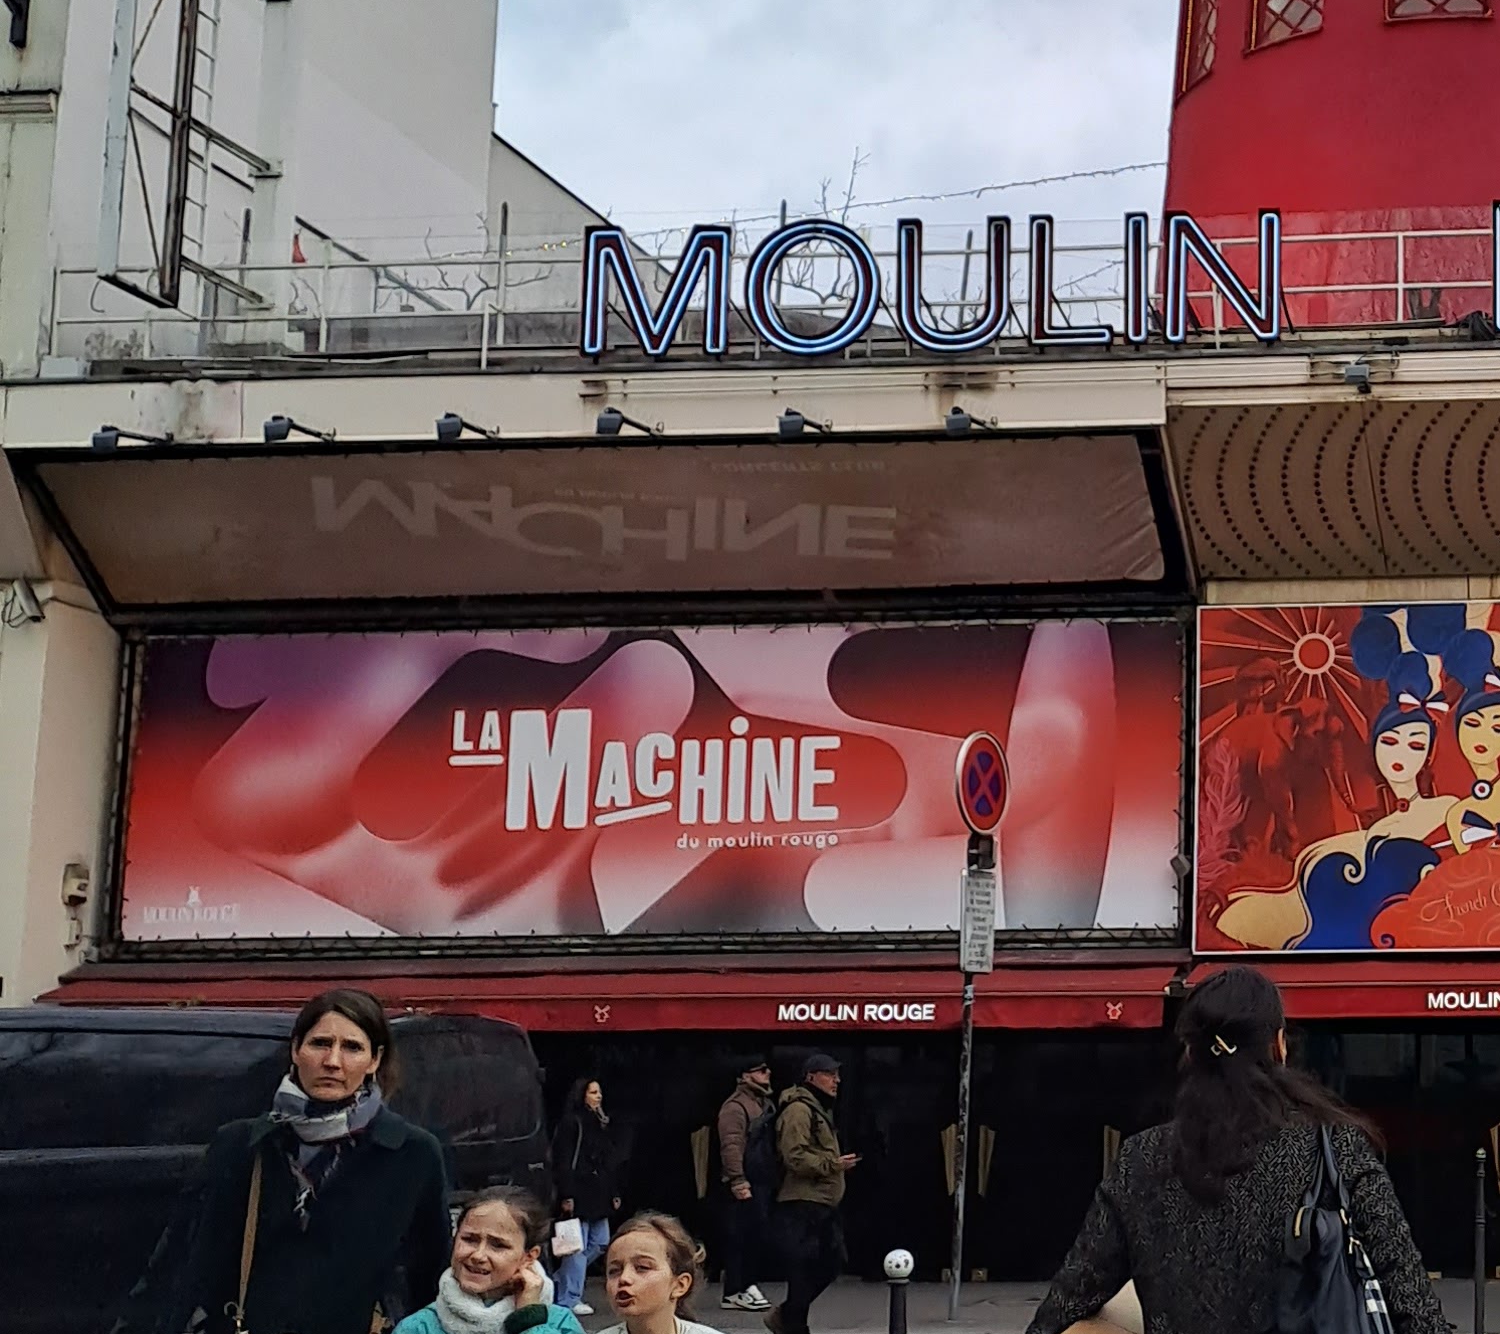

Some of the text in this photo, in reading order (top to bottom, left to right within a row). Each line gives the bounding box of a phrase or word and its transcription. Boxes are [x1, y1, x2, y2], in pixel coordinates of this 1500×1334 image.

[579, 207, 1283, 357] MOULIN
[452, 709, 501, 752] LA
[676, 832, 839, 850] du moulin rouge
[778, 1003, 936, 1021] MOULIN ROUGE
